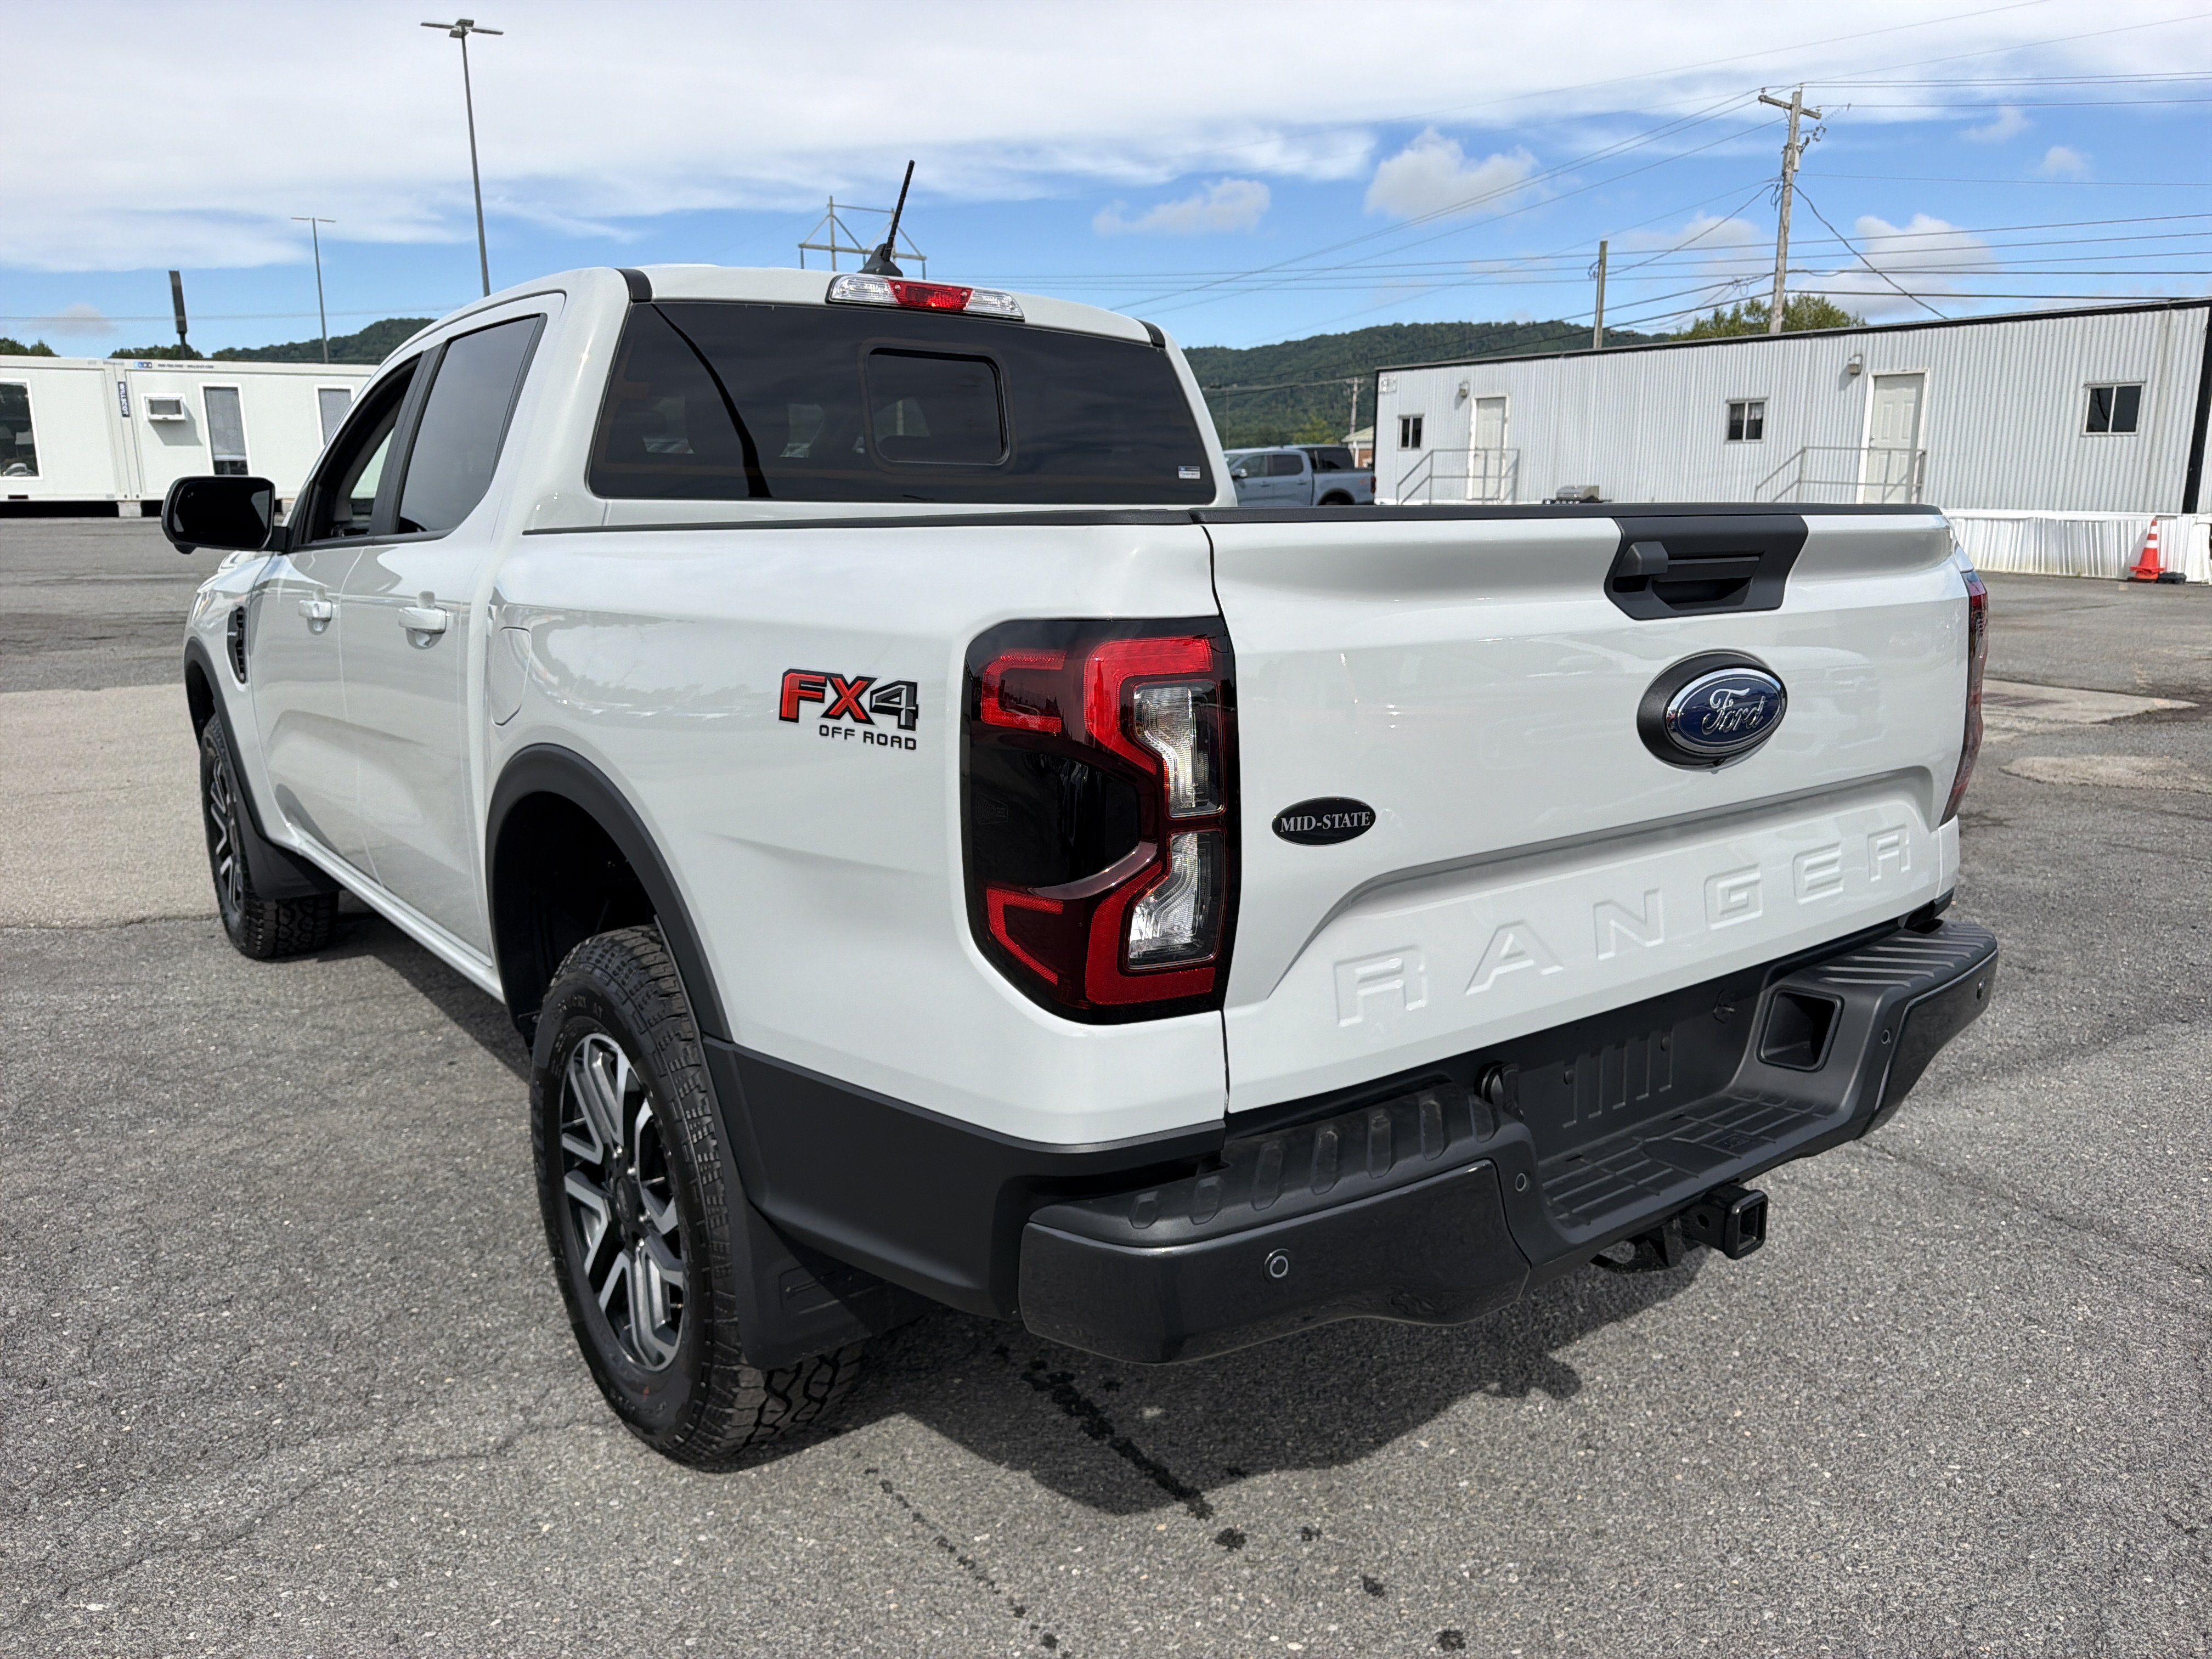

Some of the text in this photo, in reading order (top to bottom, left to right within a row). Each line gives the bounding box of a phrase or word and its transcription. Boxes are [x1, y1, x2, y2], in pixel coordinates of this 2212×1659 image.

[778, 668, 919, 732] FX4
[1701, 687, 1767, 735] Ford
[819, 724, 917, 751] OFF ROAD
[1279, 811, 1371, 833] MID-STATE
[1333, 824, 1912, 1027] RANGER
